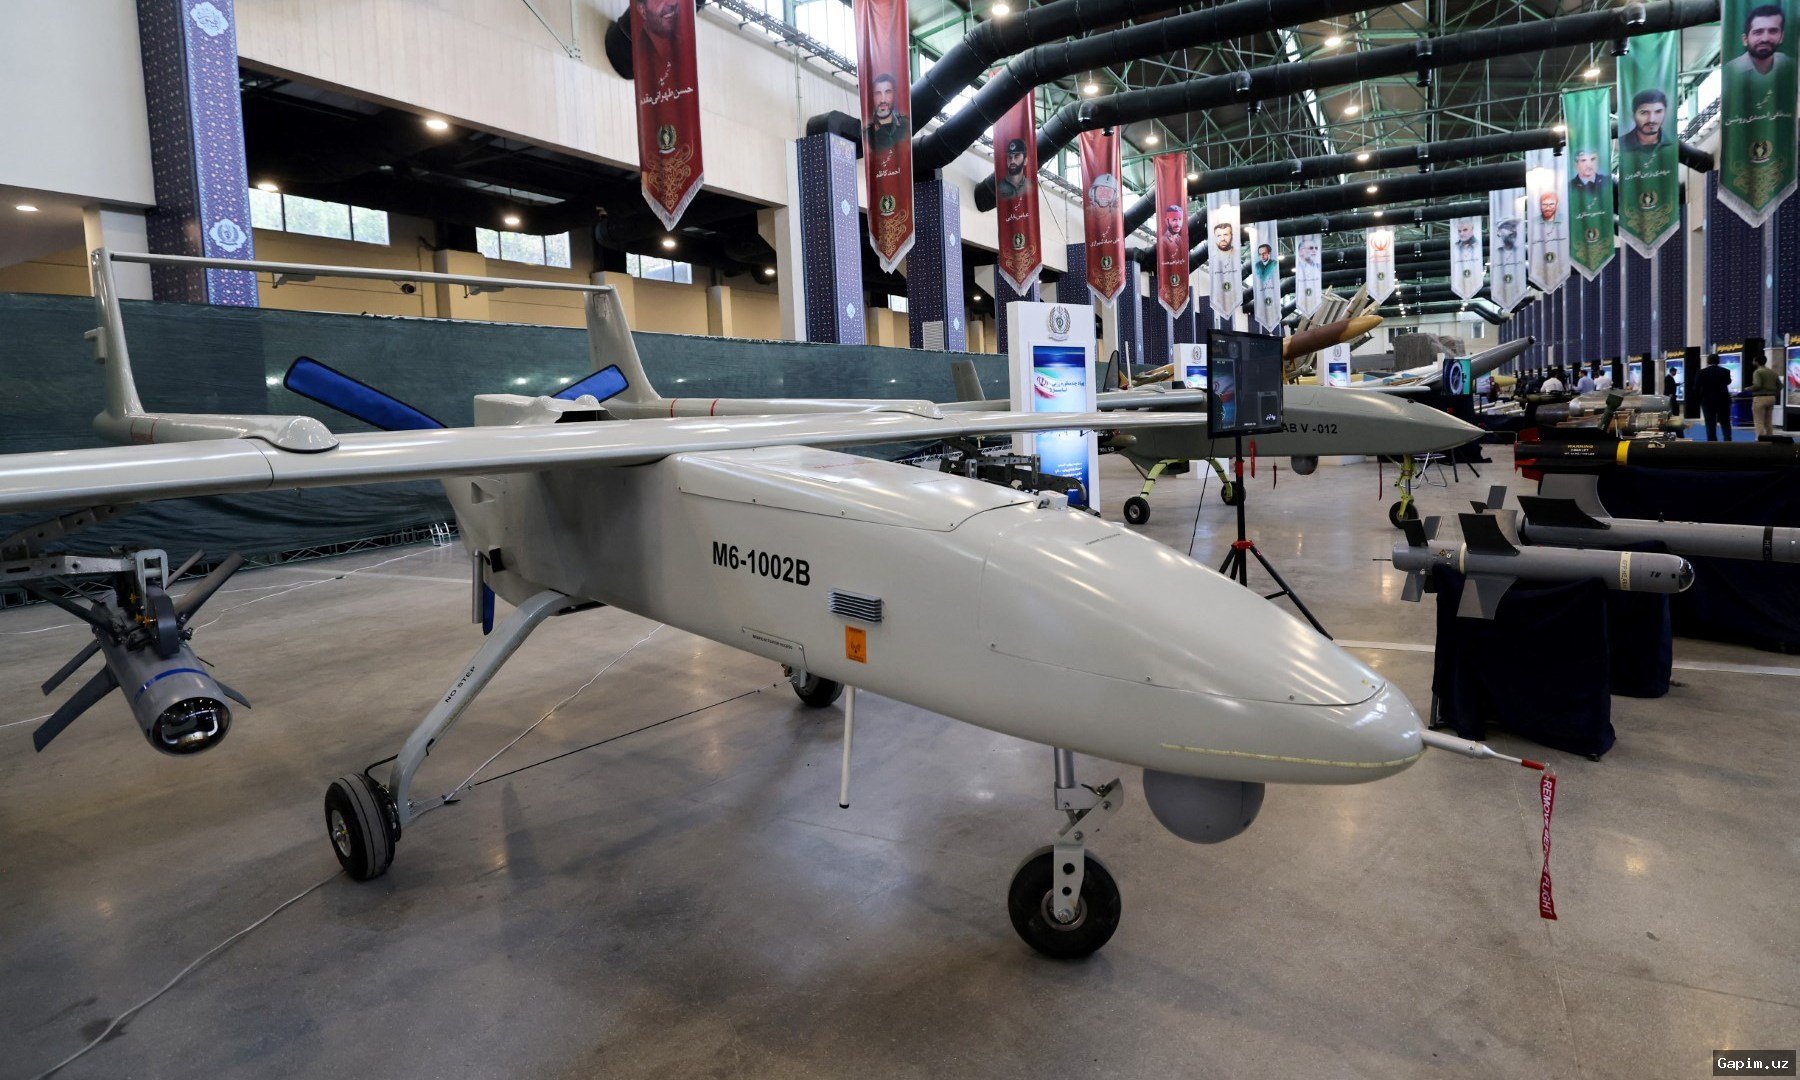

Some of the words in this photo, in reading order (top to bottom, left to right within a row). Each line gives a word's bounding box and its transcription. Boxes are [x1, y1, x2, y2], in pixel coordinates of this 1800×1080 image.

[673, 86, 694, 99] حسن
[888, 167, 901, 176] احمد
[1301, 423, 1308, 433] V
[1312, 423, 1338, 434] -012
[712, 541, 811, 587] M6-1002B
[445, 689, 457, 703] NO
[457, 666, 476, 688] STEP
[1541, 875, 1553, 915] FLIGHT
